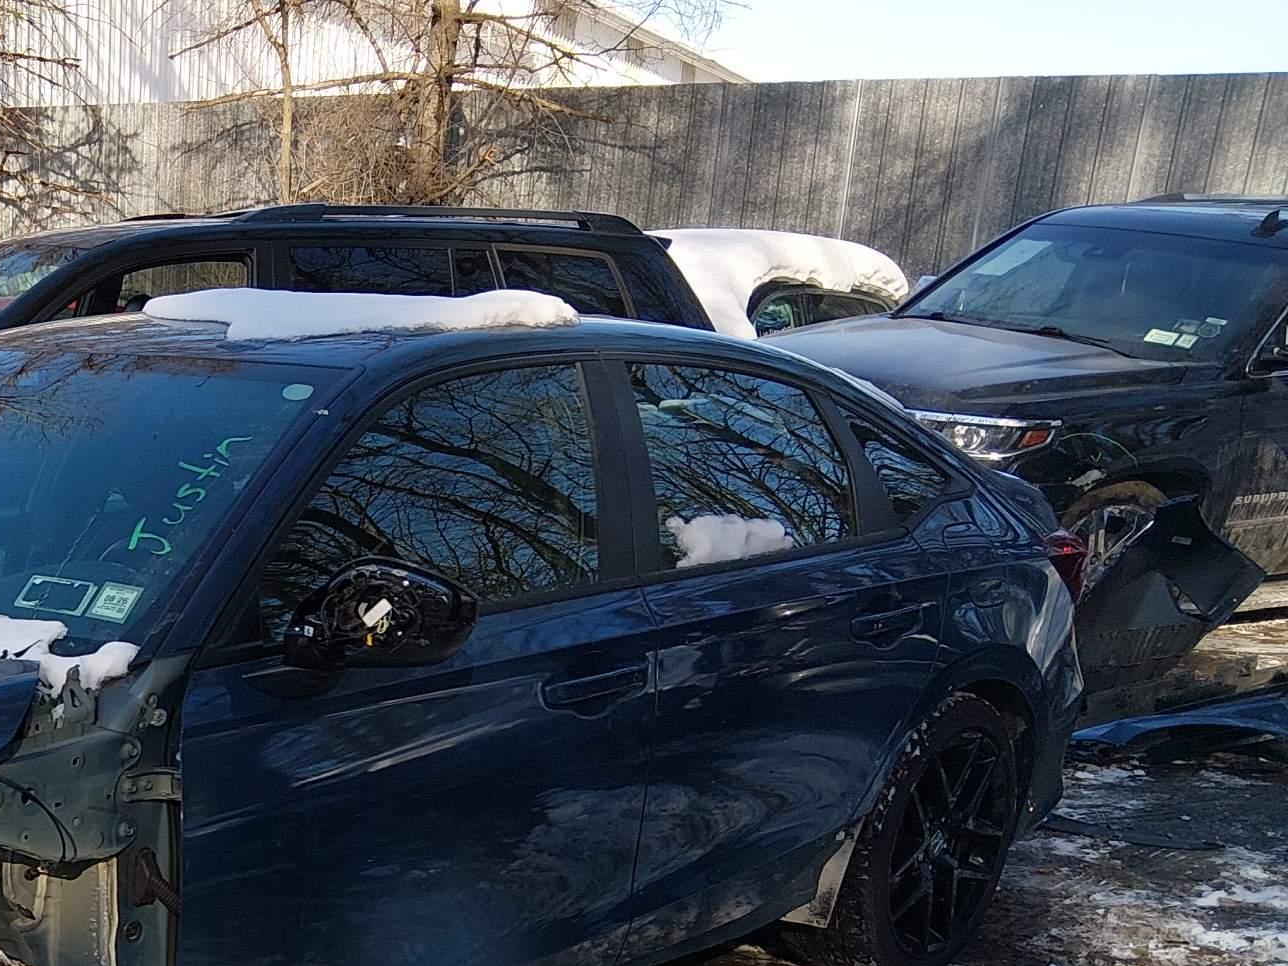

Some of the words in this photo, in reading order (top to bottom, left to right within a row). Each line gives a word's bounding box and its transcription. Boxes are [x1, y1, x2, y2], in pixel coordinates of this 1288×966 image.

[127, 435, 253, 556] Justin
[1232, 491, 1288, 505] SUBURB
[116, 596, 130, 605] 26
